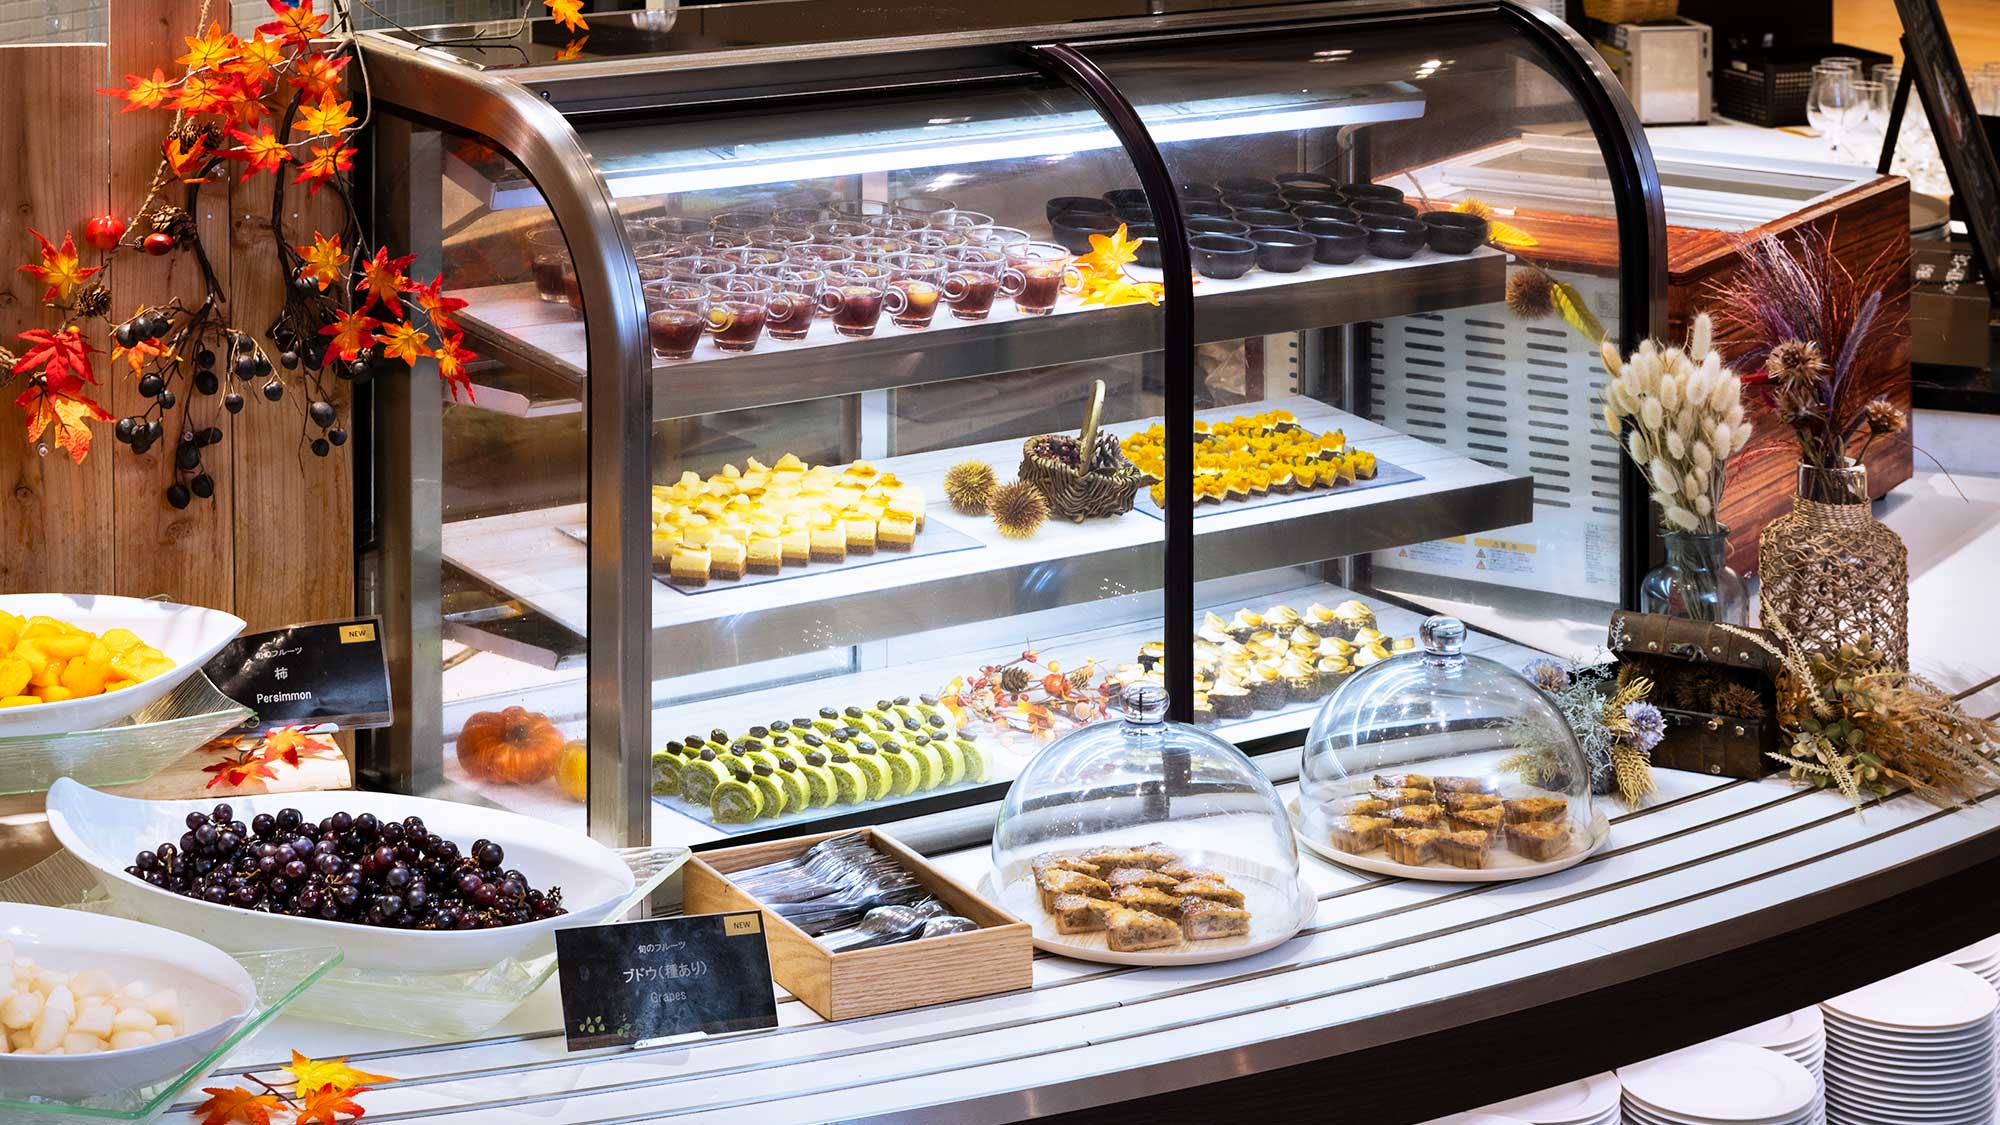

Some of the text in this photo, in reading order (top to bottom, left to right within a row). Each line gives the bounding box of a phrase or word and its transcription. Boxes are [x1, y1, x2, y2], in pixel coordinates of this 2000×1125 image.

[349, 629, 367, 638] NEW
[274, 666, 288, 680] 柿
[256, 691, 312, 704] Persimmon
[733, 920, 751, 929] NEW
[638, 941, 686, 954] 旬のフルーツ
[650, 991, 687, 1003] Grapes
